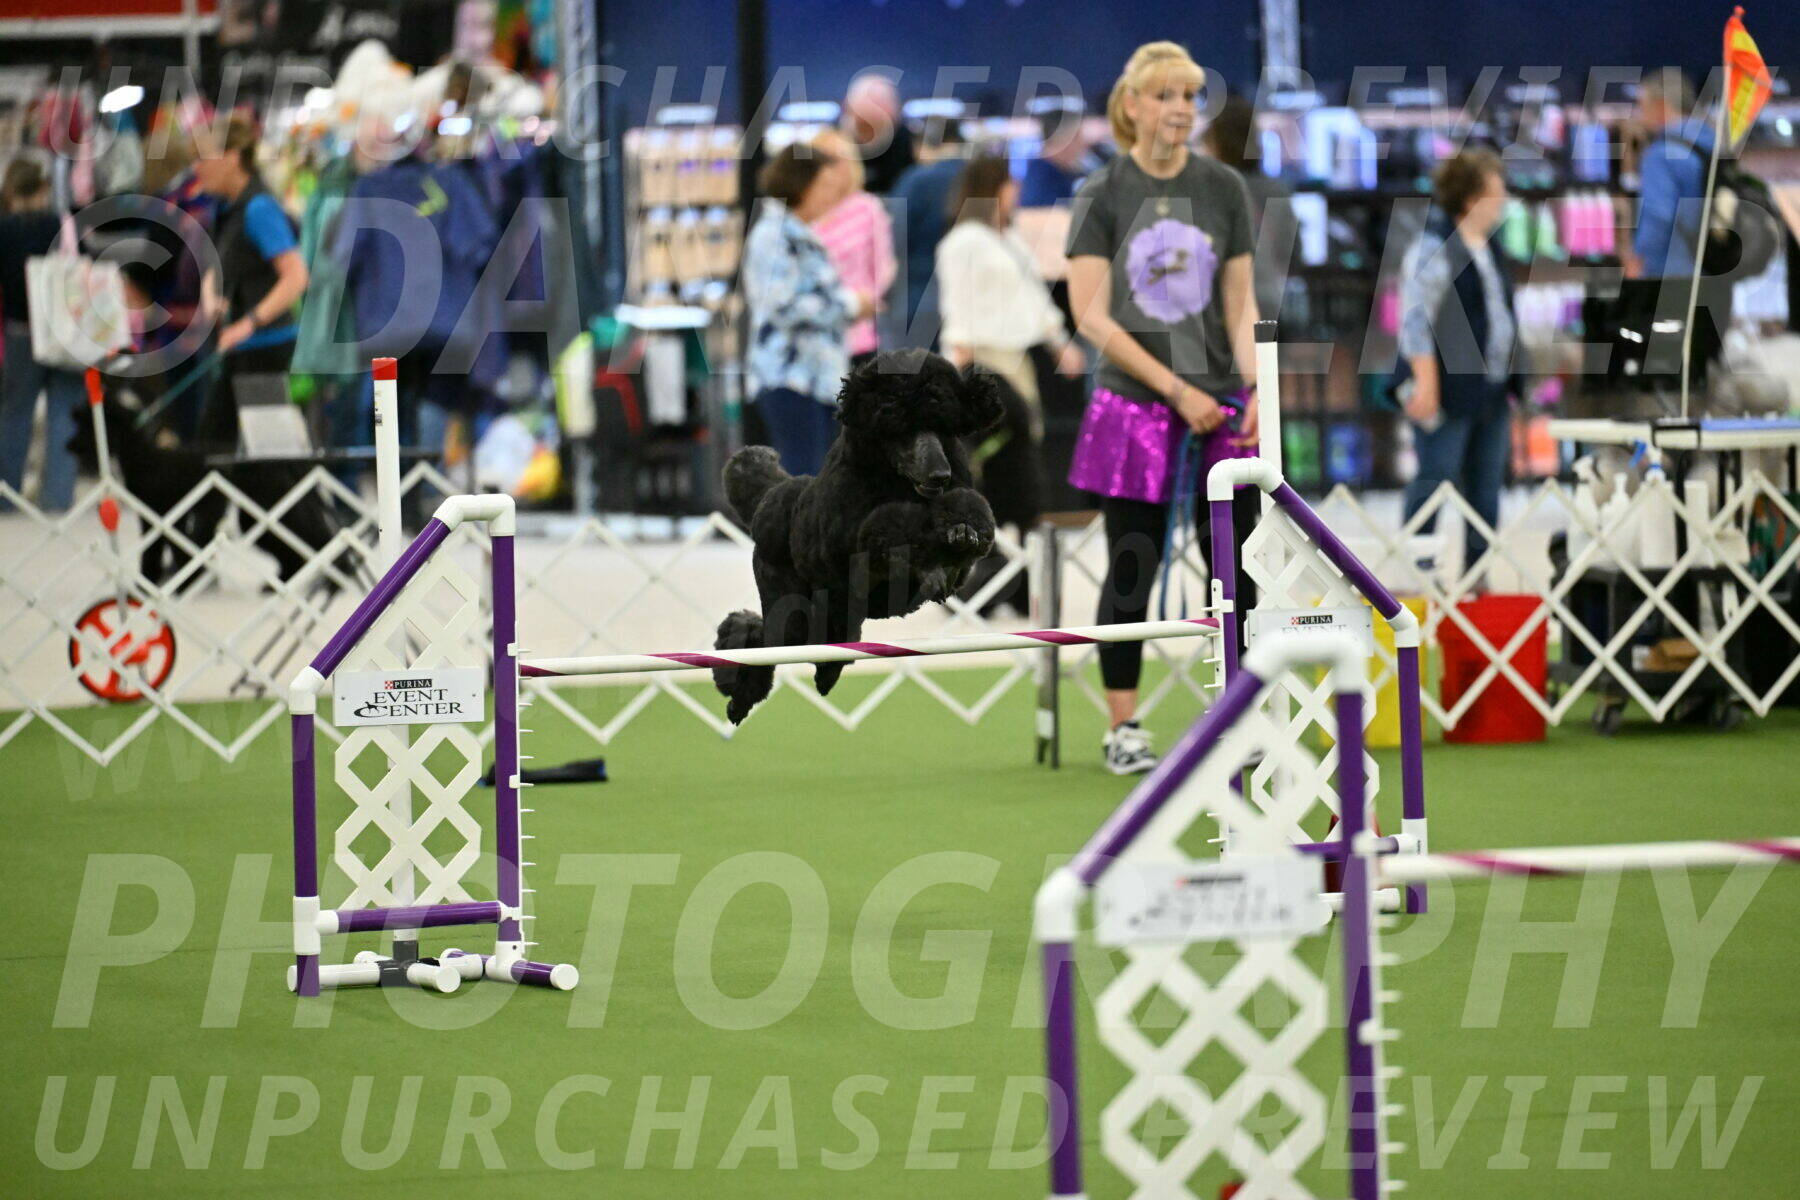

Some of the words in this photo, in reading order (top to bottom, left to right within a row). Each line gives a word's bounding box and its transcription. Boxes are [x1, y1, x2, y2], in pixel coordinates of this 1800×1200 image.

[1300, 616, 1331, 624] PURINA
[395, 680, 431, 688] PURINA
[374, 689, 448, 703] EVENT
[354, 702, 463, 718] CENTER
